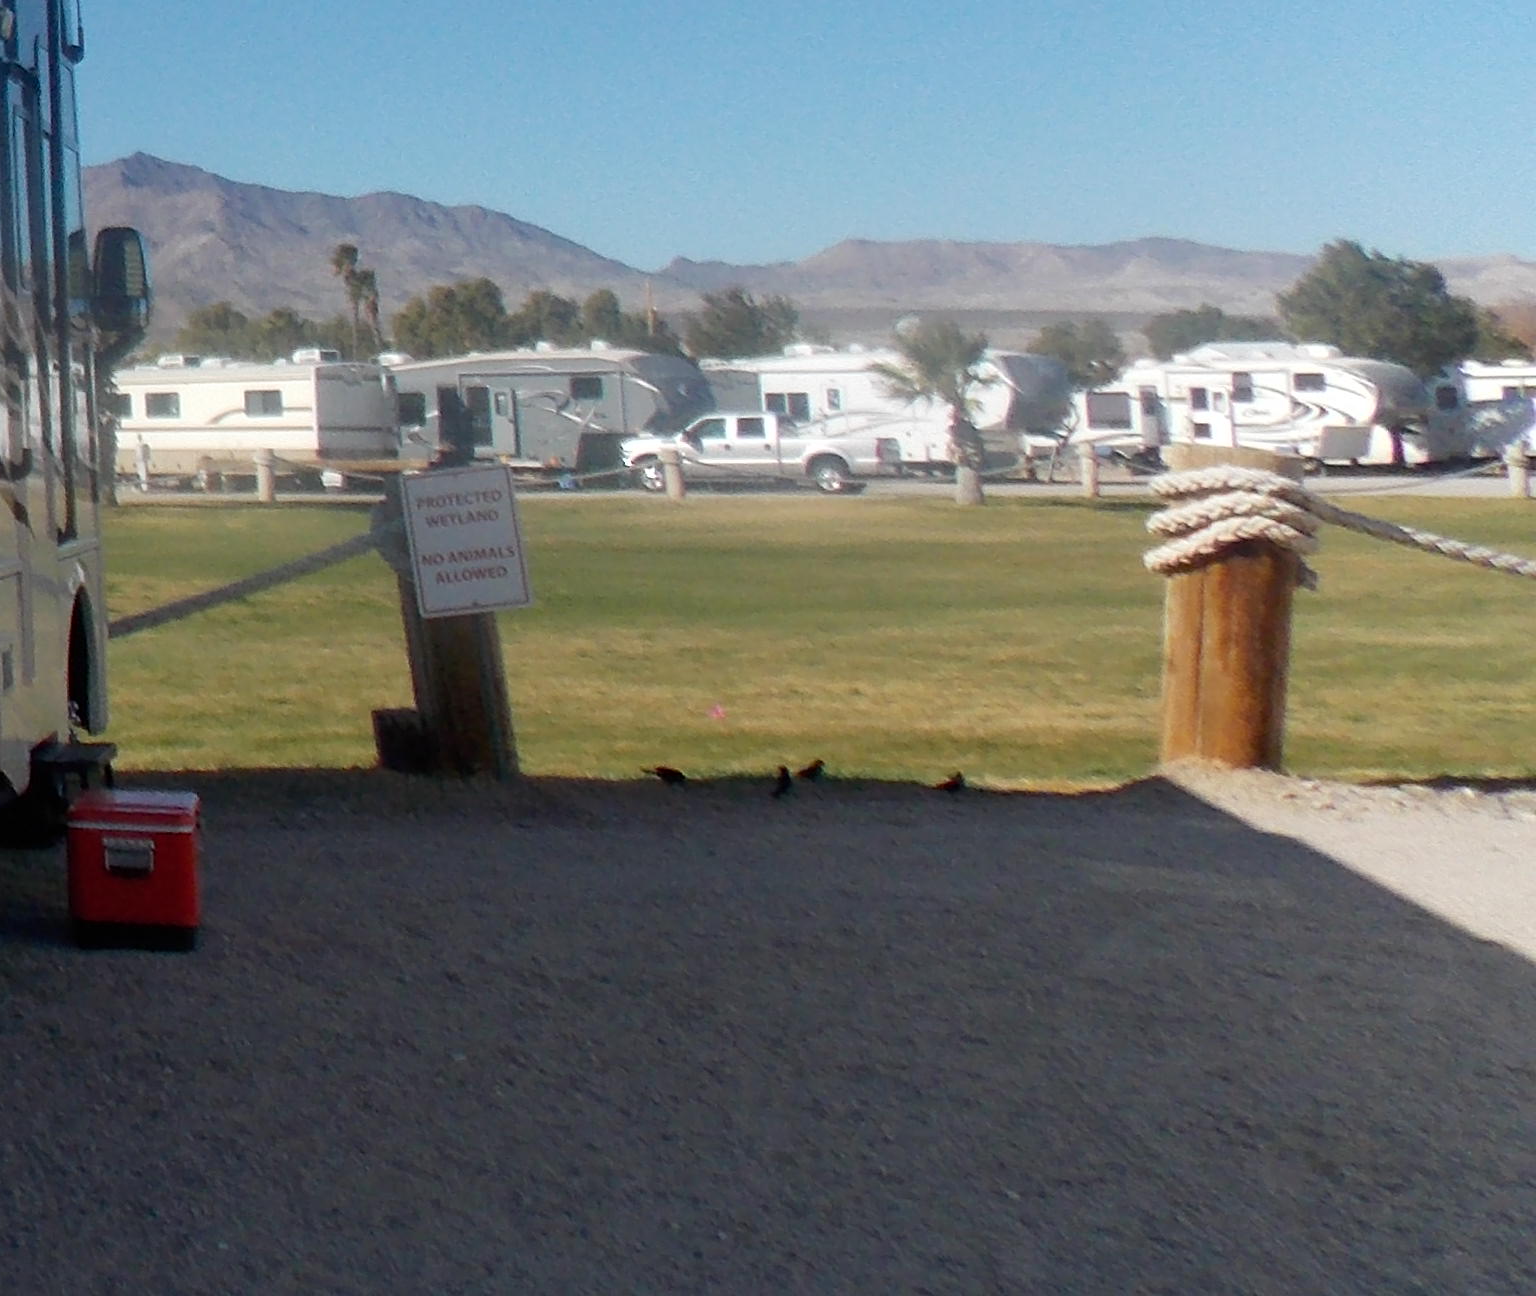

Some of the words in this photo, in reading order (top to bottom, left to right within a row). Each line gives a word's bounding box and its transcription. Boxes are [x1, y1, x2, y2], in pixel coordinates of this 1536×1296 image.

[416, 489, 503, 511] PROTECTED
[426, 509, 500, 528] WETLAND
[421, 554, 445, 567] NO
[449, 546, 517, 564] ANIMALS
[435, 566, 508, 584] ALLOWED
